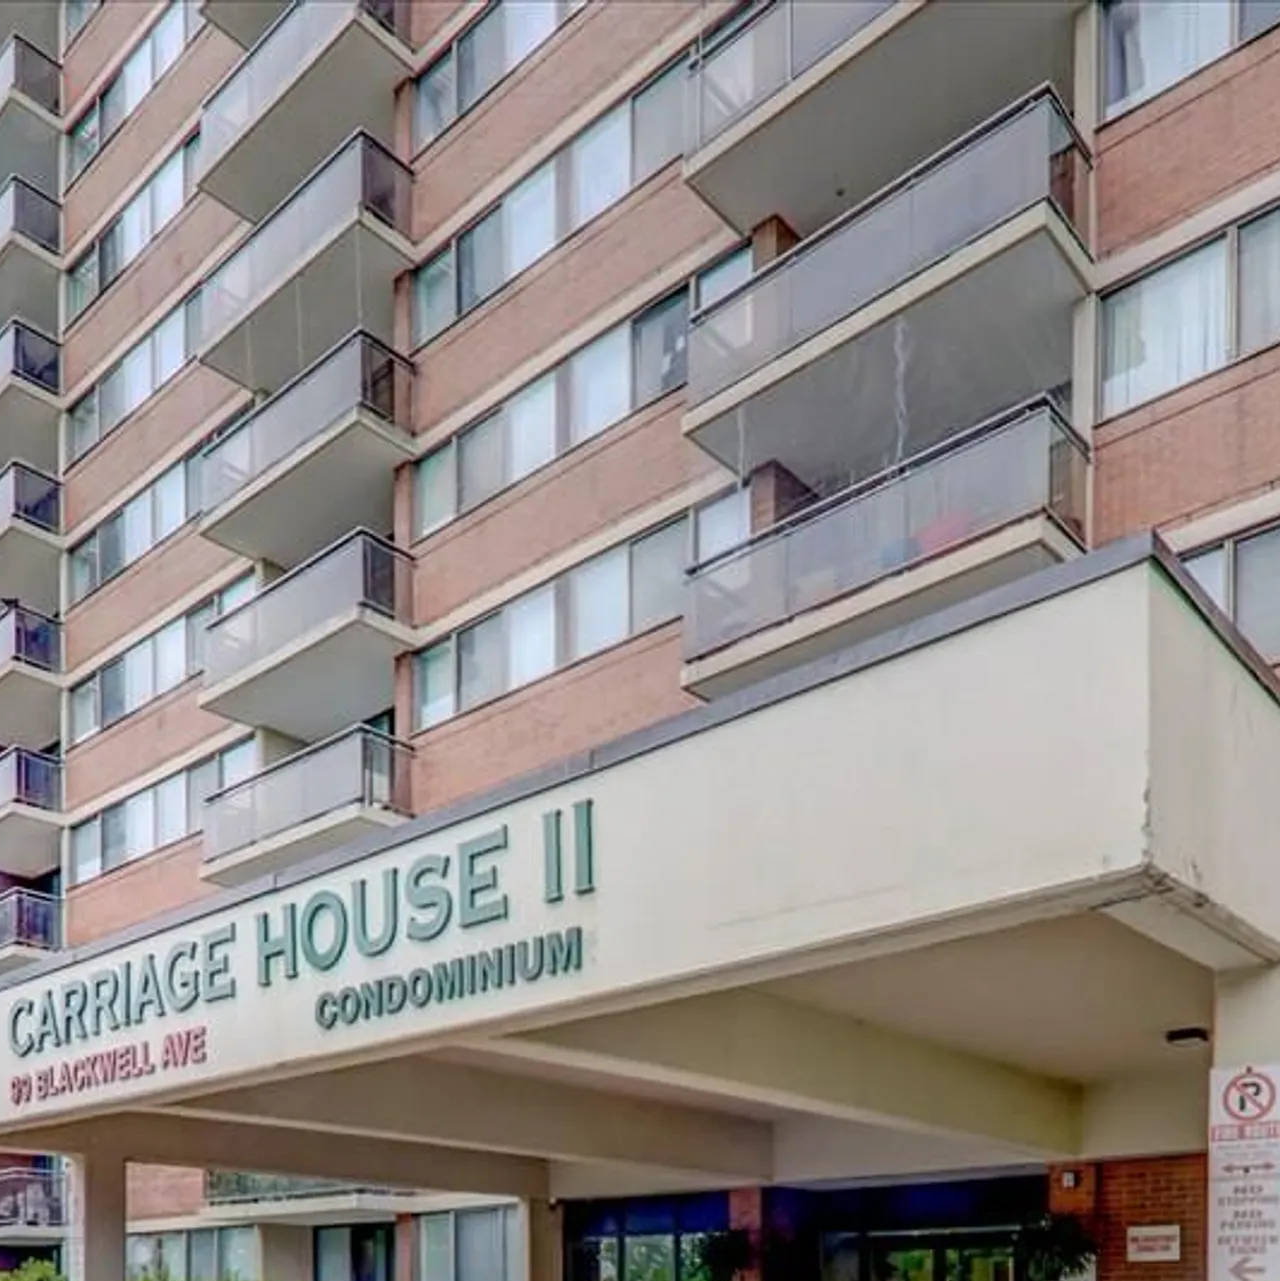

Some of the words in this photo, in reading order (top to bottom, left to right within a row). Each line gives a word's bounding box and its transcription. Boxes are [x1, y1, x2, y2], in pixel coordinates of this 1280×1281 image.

[10, 922, 237, 1058] CARRIAGE
[255, 824, 509, 987] HOUSE
[544, 798, 595, 902] II
[315, 926, 584, 1030] CONDOMINIUM
[35, 1041, 156, 1101] BLACKWELL
[162, 1025, 208, 1070] AVE
